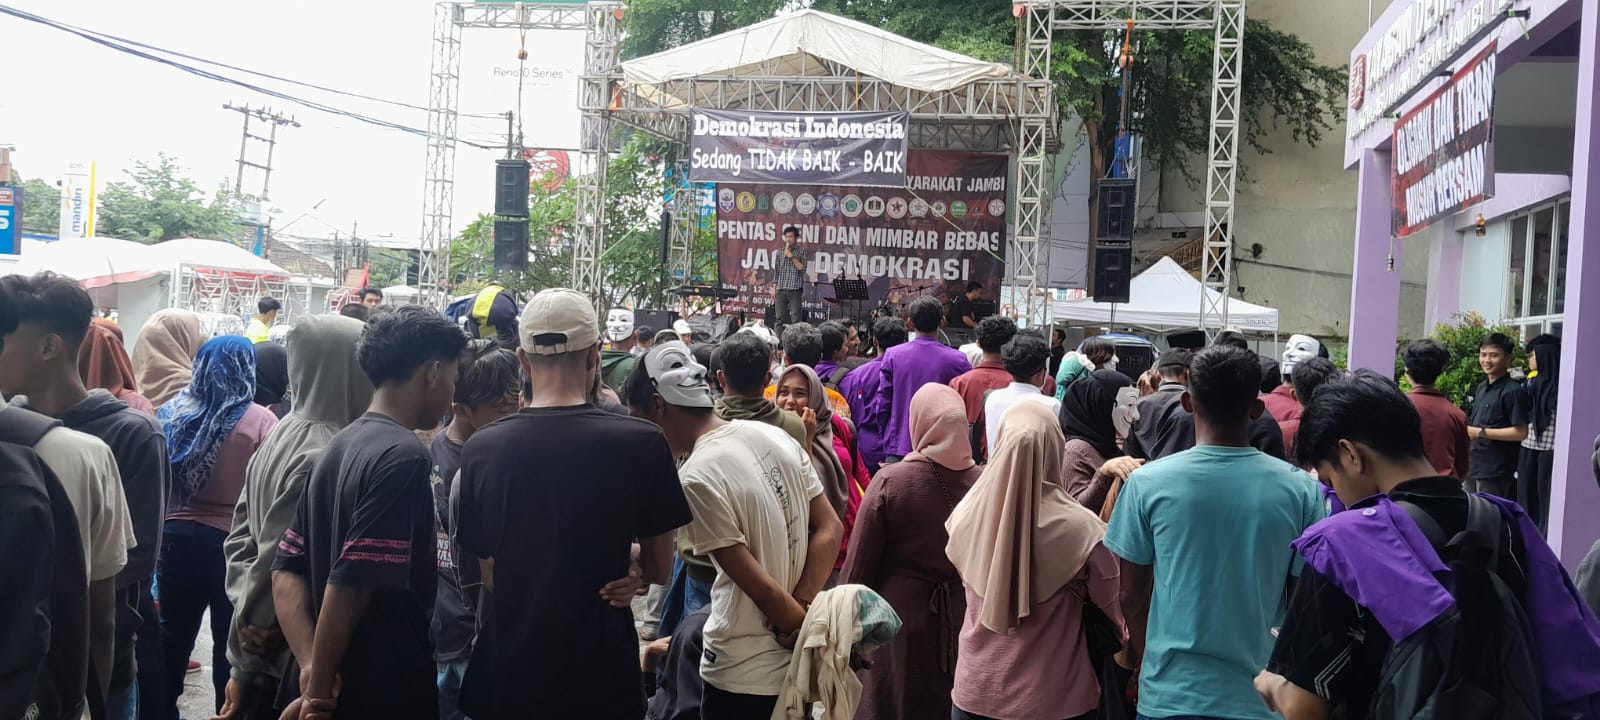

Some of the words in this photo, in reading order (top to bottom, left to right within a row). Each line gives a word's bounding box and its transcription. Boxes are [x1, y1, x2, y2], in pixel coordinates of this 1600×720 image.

[532, 68, 564, 78] Series
[693, 114, 800, 138] Demokrasi
[804, 117, 904, 139] Indonesia
[1397, 104, 1433, 176] OLIGARKI
[1434, 87, 1455, 150] DAN
[692, 148, 742, 176] Sedang
[747, 149, 796, 171] TIDAK
[802, 150, 841, 172] BAIK
[863, 150, 903, 173] BAIK
[967, 177, 1005, 192] JAMBI
[72, 187, 82, 232] mandiri
[1406, 173, 1436, 228] MUSUH
[718, 220, 776, 241] PENTAS
[825, 227, 860, 246] DAN
[866, 228, 938, 250] MIMBAR
[944, 231, 1000, 251] BEBAS
[815, 251, 970, 281] DEMOKRASI
